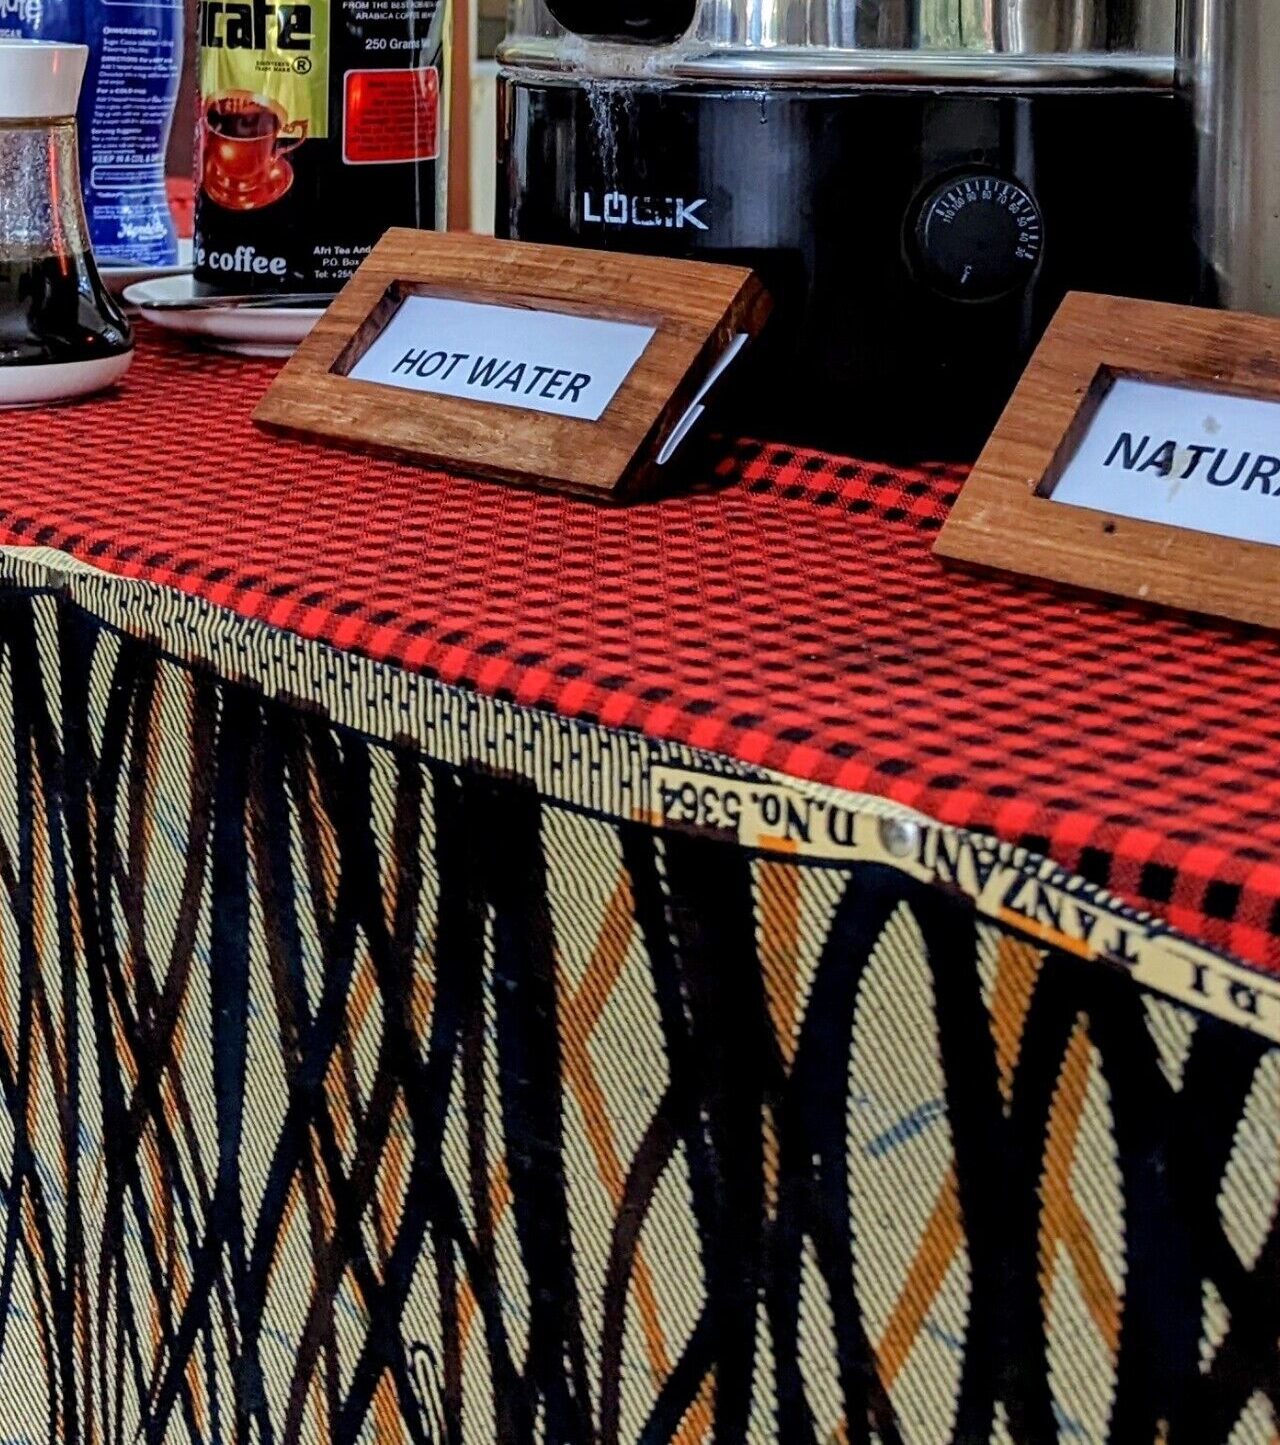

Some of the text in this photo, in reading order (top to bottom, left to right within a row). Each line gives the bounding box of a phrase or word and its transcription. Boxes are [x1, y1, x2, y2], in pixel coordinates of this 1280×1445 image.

[342, 1, 369, 10] FROM
[372, 1, 389, 9] THE
[365, 38, 387, 50] 250
[389, 38, 420, 50] Grams
[208, 245, 288, 276] coffee
[391, 347, 592, 404] HOT WATER
[659, 779, 743, 832] 5364
[914, 822, 1140, 966] TANZANI
